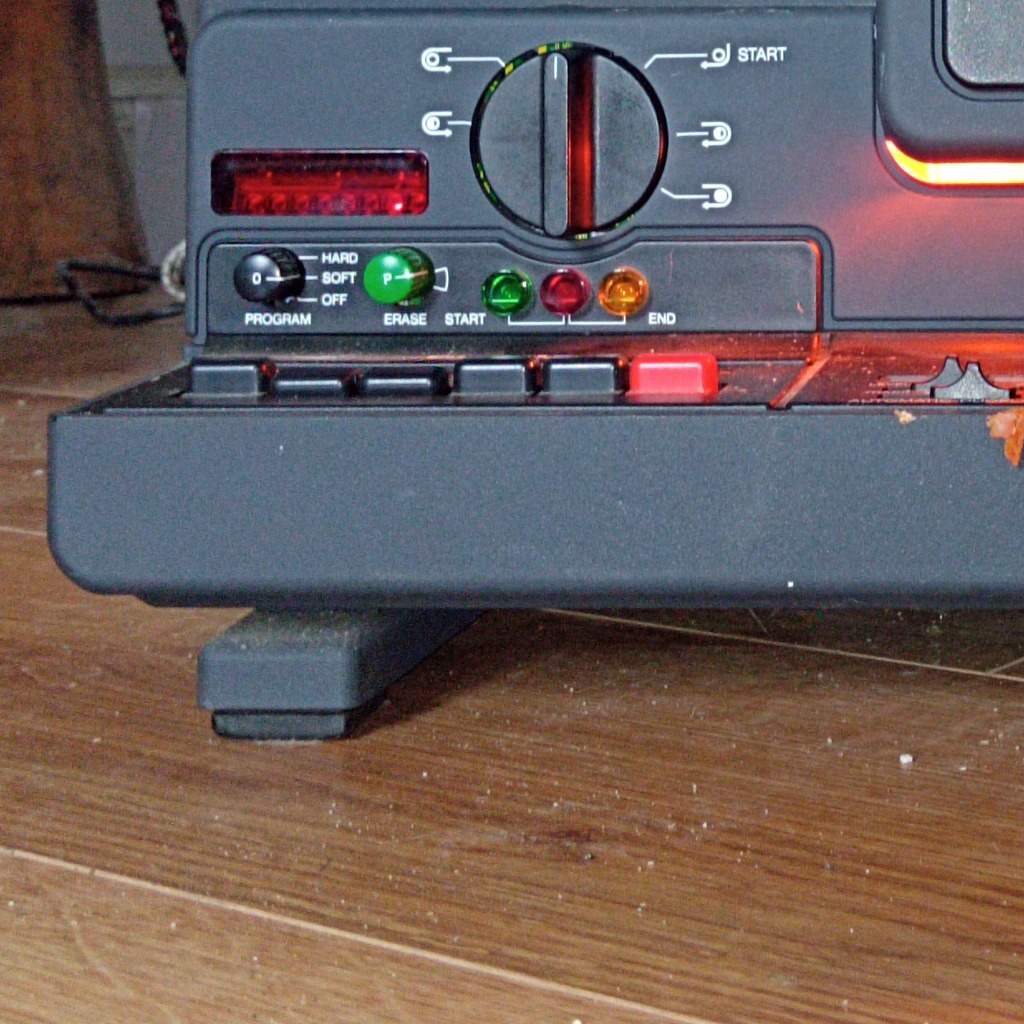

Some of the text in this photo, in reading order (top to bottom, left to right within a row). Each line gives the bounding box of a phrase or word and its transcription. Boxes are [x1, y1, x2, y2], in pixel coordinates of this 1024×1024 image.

[737, 46, 788, 61] START
[321, 251, 359, 264] HARD
[321, 272, 357, 285] SOFT
[383, 273, 393, 286] P
[321, 293, 348, 306] OFF
[244, 312, 312, 326] PROGRAM
[384, 312, 427, 326] ERASE
[444, 312, 487, 326] START
[648, 312, 677, 326] END
